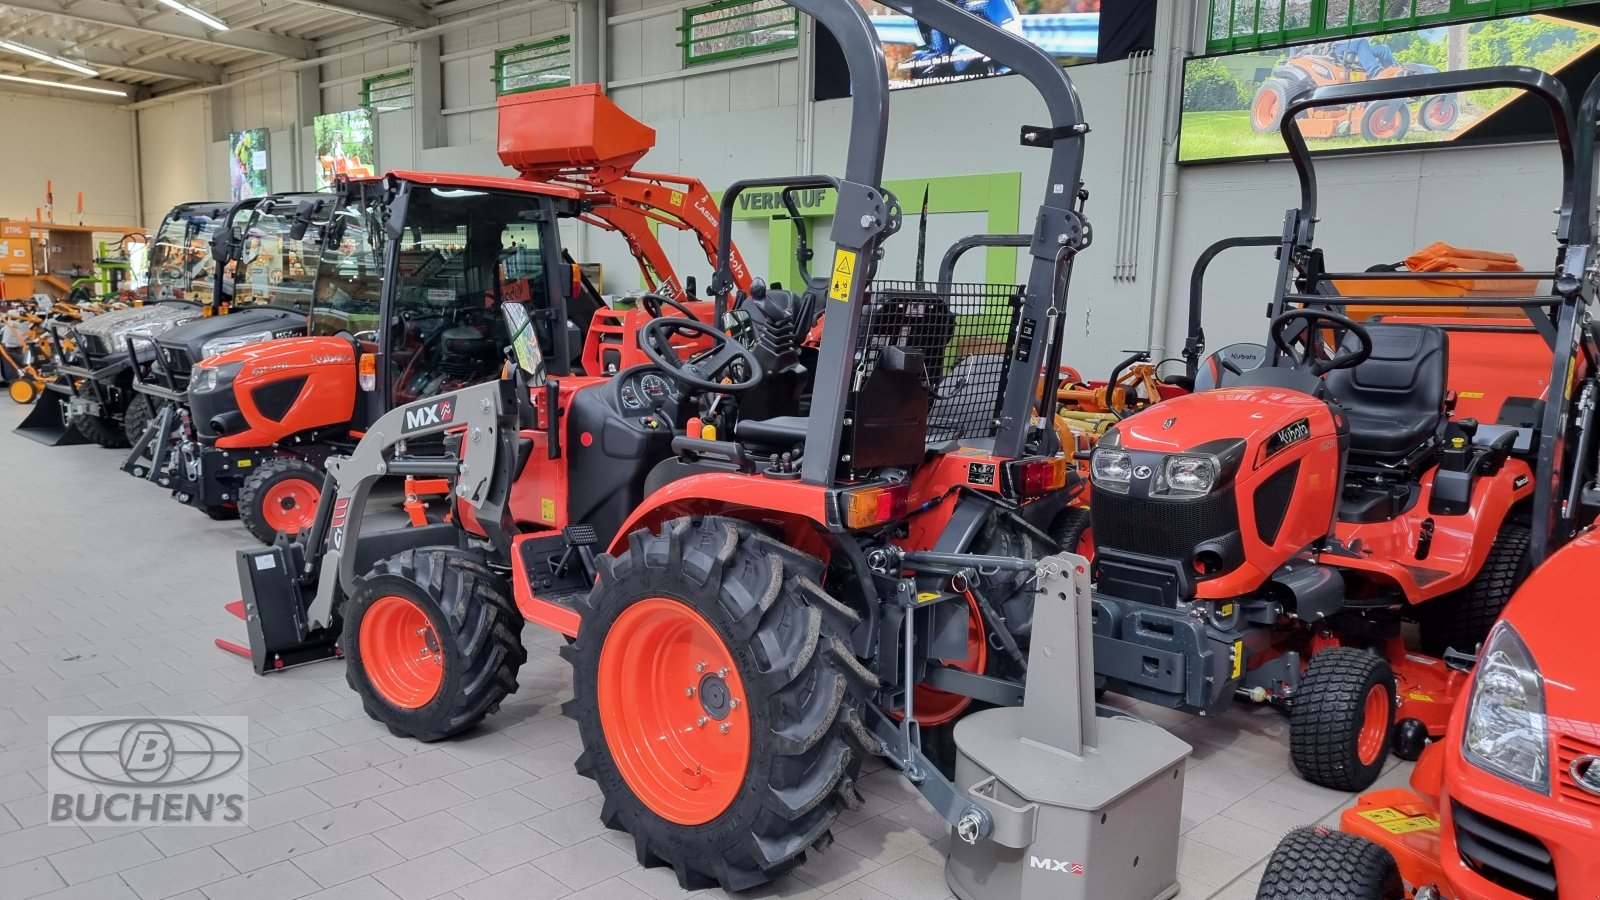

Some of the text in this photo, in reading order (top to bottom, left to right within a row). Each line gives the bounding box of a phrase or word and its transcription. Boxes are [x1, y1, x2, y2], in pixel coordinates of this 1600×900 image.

[739, 189, 826, 210] VERKAUF
[730, 249, 744, 279] bota
[406, 403, 440, 430] MX
[1278, 422, 1308, 444] Kubota
[1030, 855, 1070, 873] MX
